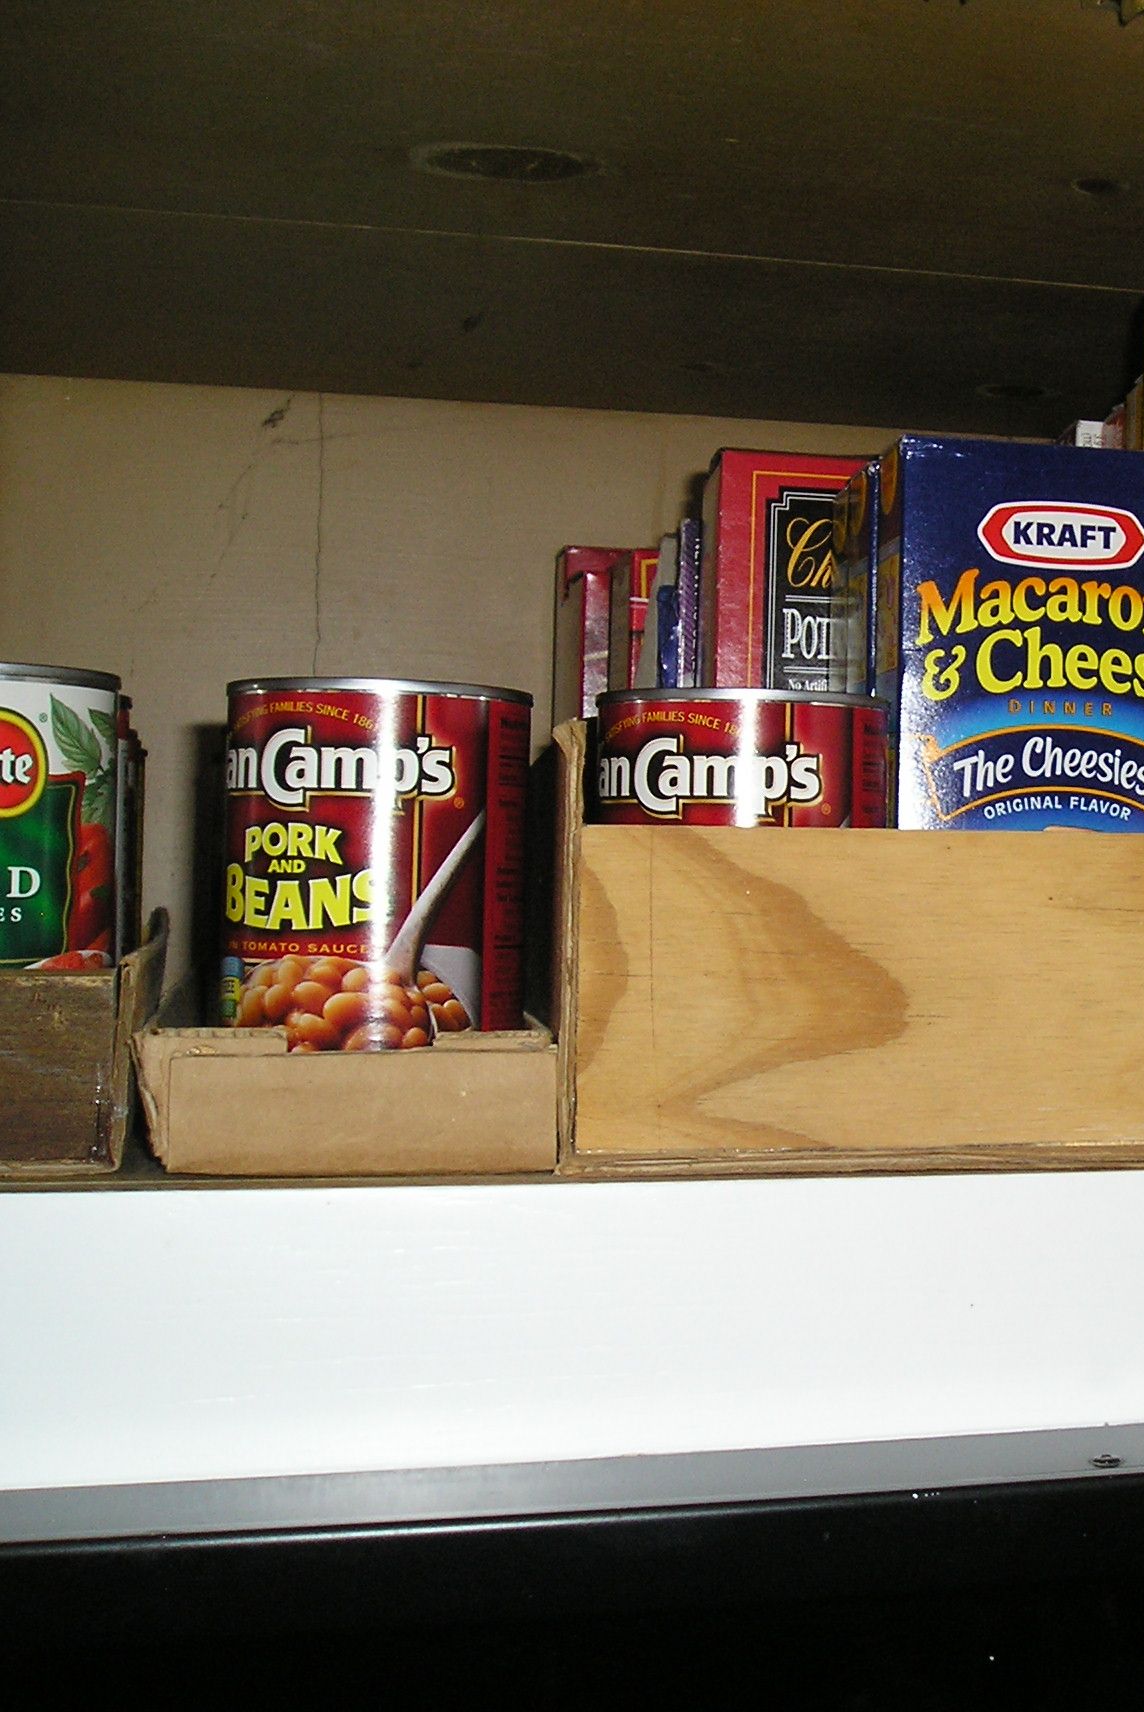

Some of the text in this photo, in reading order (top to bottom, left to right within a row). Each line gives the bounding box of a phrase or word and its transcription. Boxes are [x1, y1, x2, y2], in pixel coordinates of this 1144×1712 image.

[1012, 520, 1117, 550] KRAFT
[921, 648, 967, 703] &
[270, 701, 313, 714] FAMILIES
[316, 704, 349, 721] SINCE
[353, 713, 377, 731] 186
[642, 711, 685, 724] FAMILIES
[687, 712, 721, 730] SINCE
[1007, 699, 1114, 717] DINNER
[261, 728, 452, 806] Camp's
[953, 750, 1015, 798] The
[982, 794, 1132, 822] ORIGINAL FLAVOR
[245, 822, 343, 867] PORK
[267, 857, 306, 874] AND
[226, 863, 389, 931] BEANS
[241, 941, 300, 953] TOMATO
[307, 943, 369, 954] SAUCE
